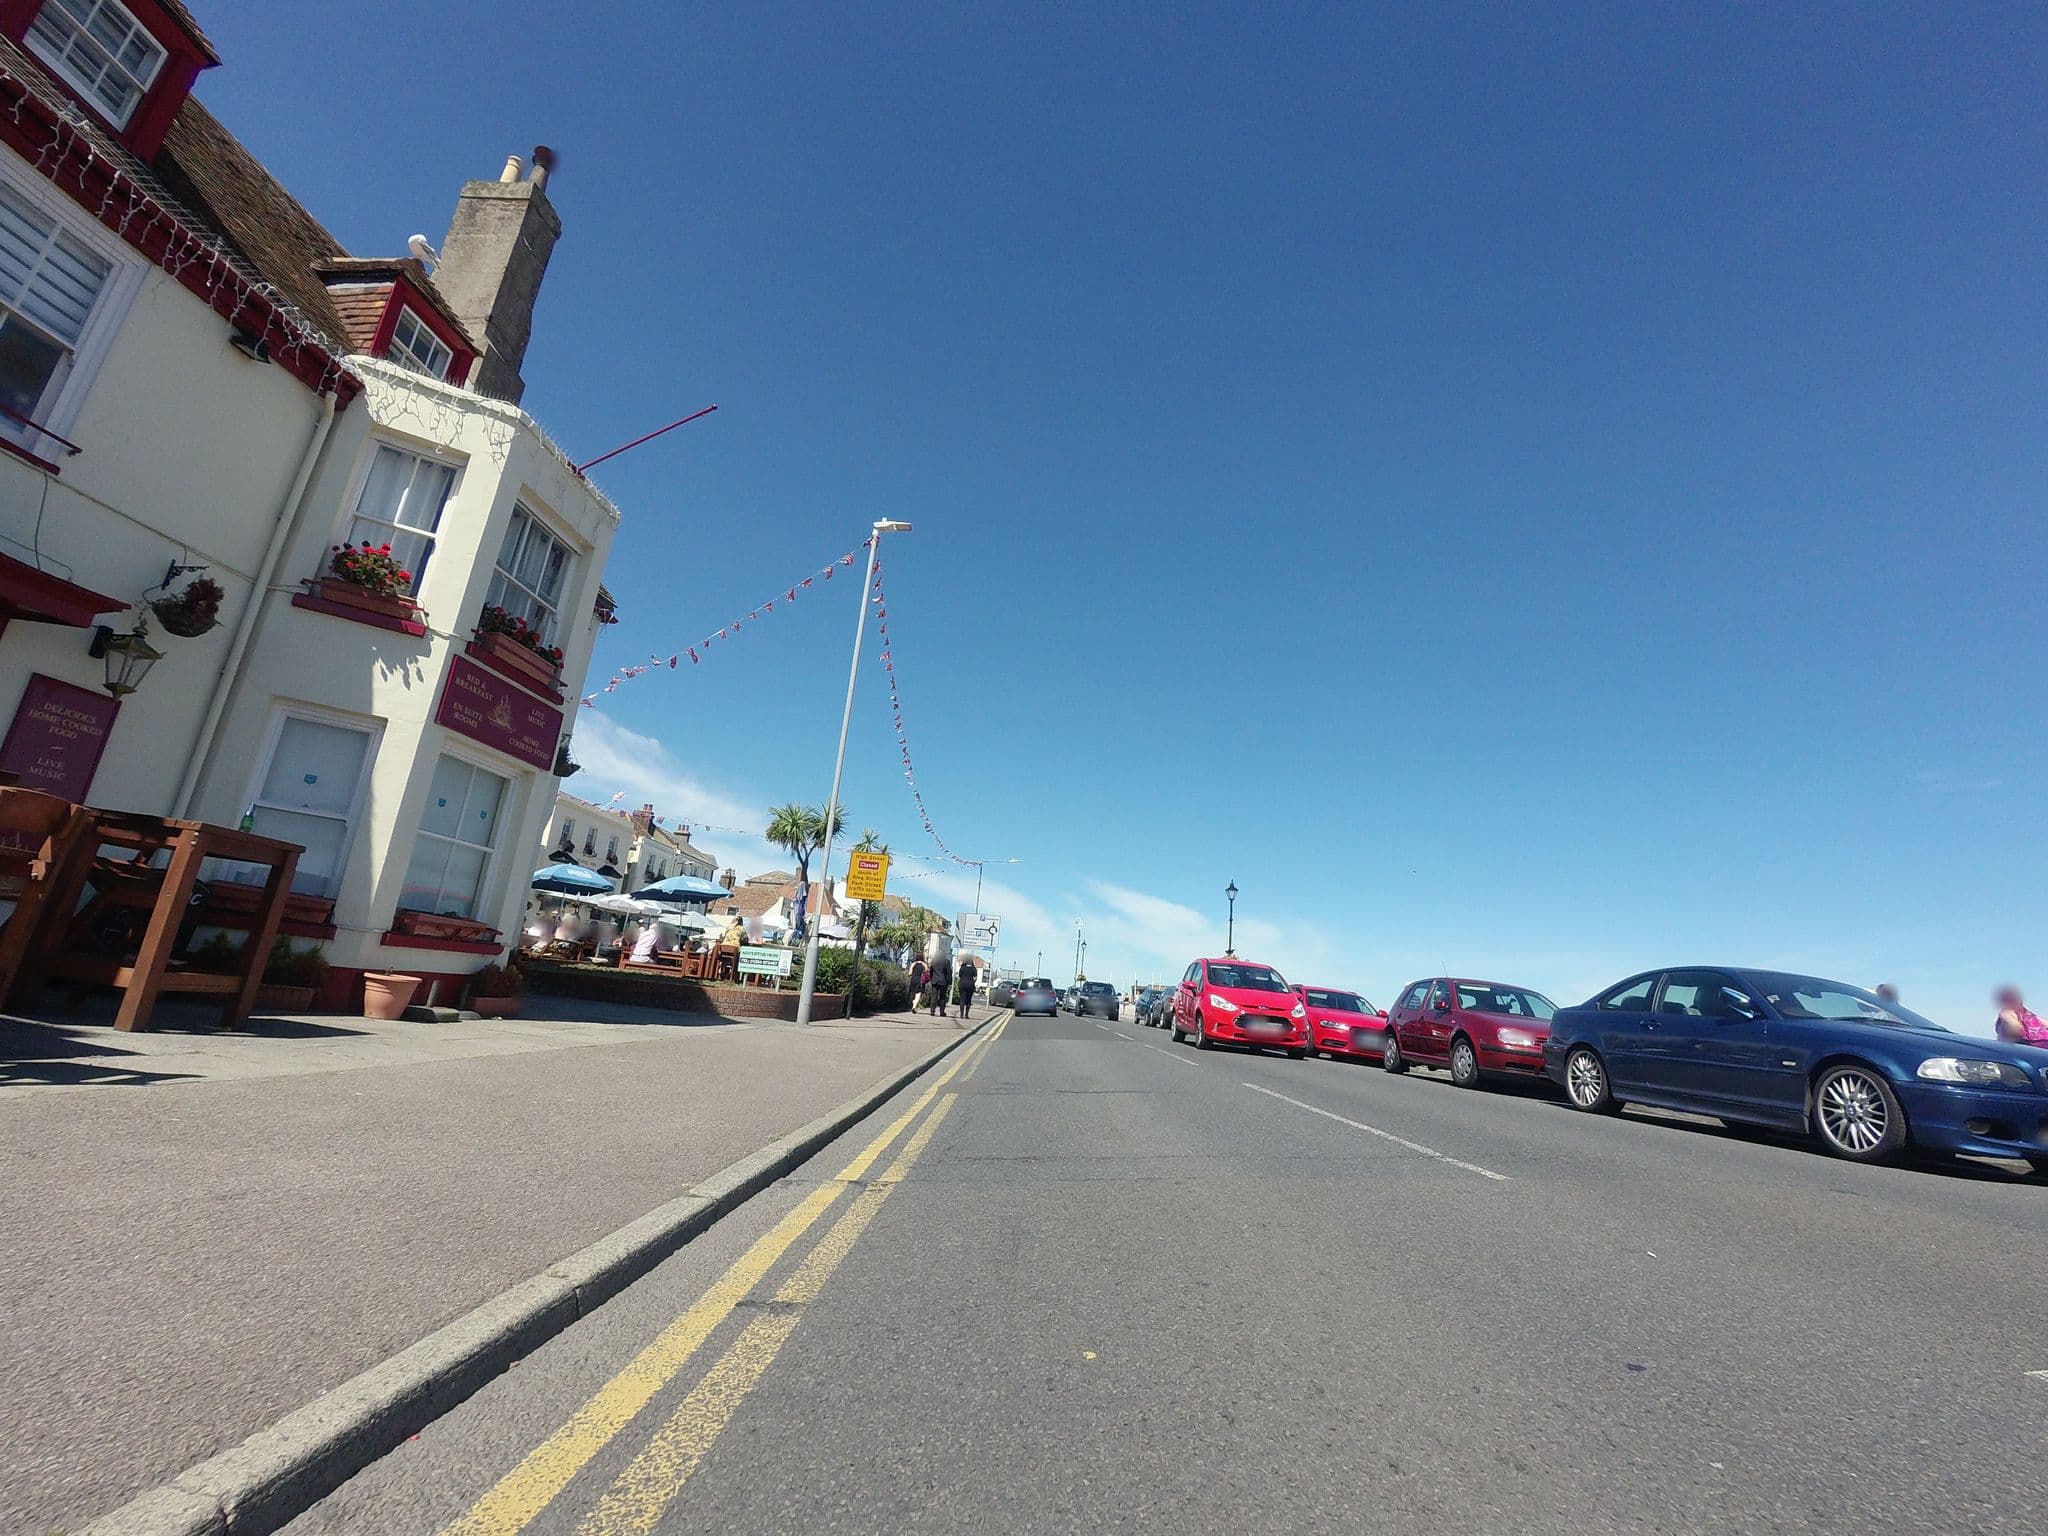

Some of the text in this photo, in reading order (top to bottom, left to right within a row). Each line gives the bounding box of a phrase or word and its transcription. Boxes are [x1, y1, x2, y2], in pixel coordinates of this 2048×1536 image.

[466, 673, 480, 686] BED
[455, 677, 494, 702] BREAKFAST
[44, 702, 97, 724] DELICIOUS
[453, 702, 483, 721] EN SUITE
[531, 709, 545, 720] LIVE
[28, 709, 103, 736] HOME COOKED
[454, 711, 479, 729] ROOMS
[528, 715, 547, 729] MUSIC
[48, 726, 78, 740] FOOD
[509, 738, 549, 760] COOKED FOOD
[36, 757, 66, 770] LIVE
[28, 766, 66, 781] MUSIC
